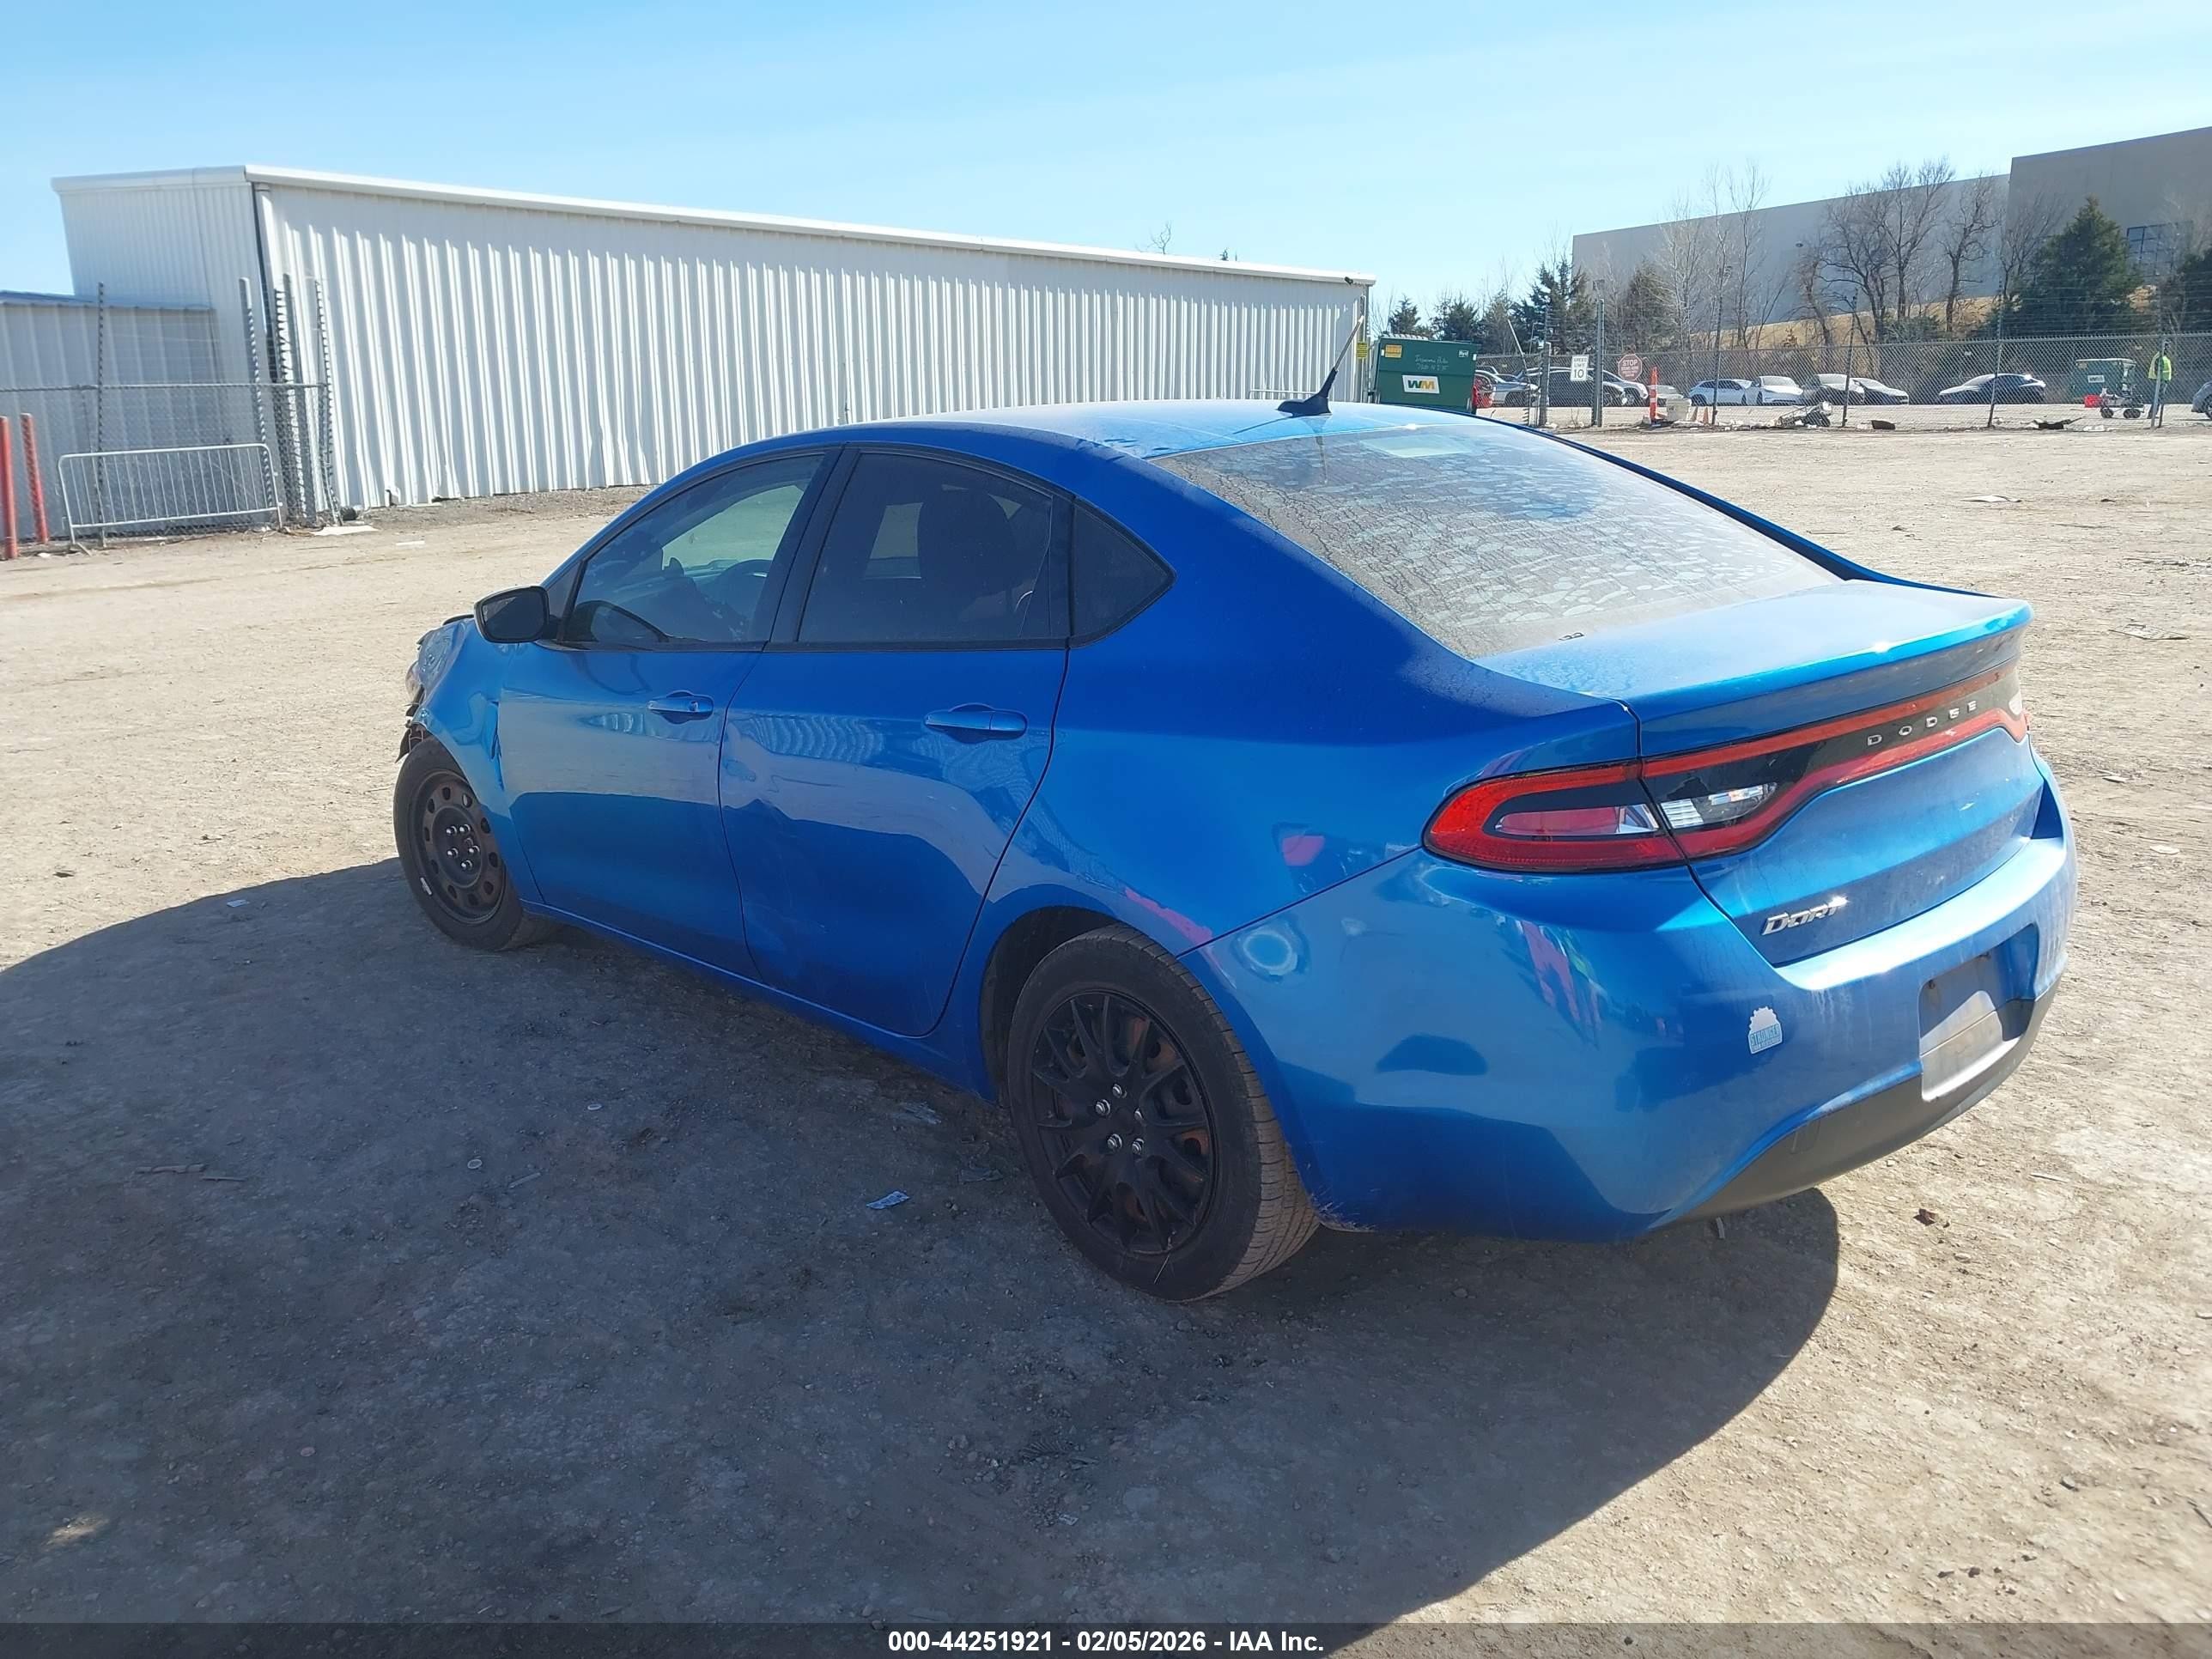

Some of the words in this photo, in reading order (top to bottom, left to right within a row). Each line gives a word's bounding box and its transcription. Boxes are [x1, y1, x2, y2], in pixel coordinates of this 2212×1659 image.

[1574, 368, 1584, 379] 10
[1407, 380, 1435, 389] WM
[1867, 700, 1978, 746] DODGE
